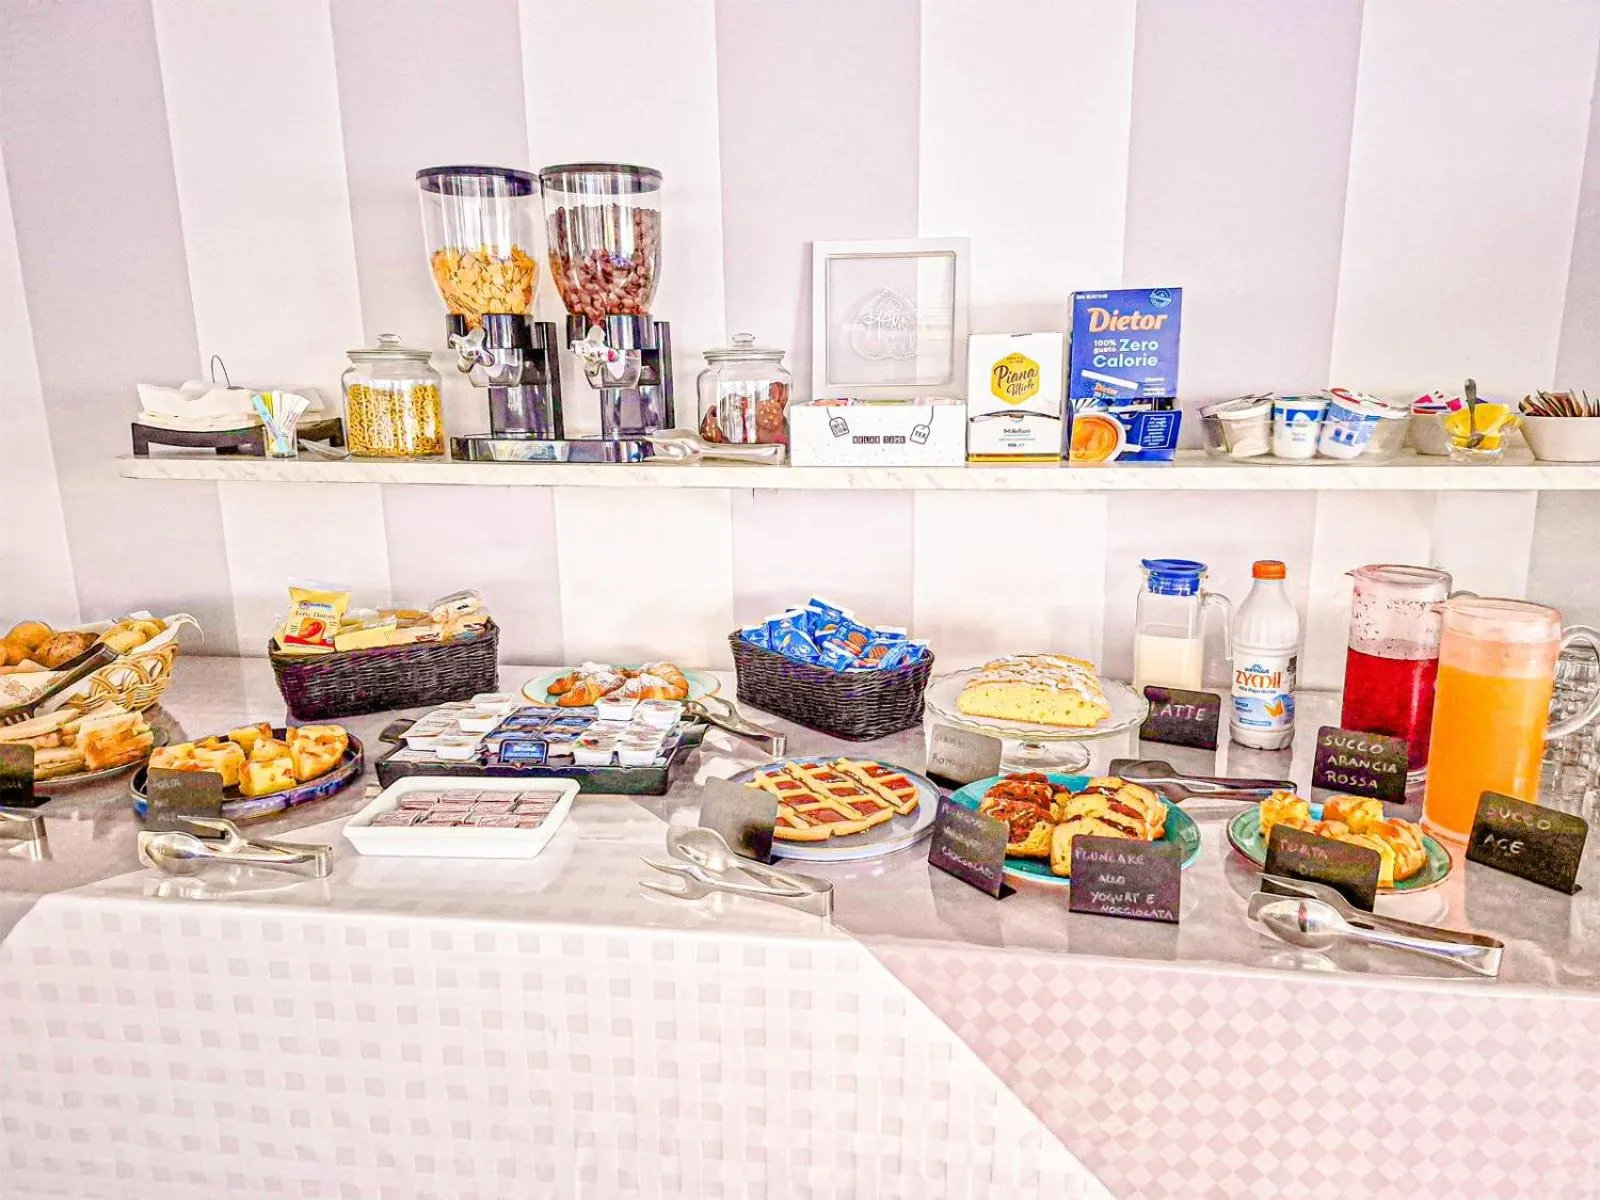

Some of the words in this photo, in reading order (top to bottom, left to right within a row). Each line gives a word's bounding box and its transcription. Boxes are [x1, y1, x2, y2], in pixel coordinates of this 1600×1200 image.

[1087, 307, 1169, 333] Dietor
[1093, 339, 1117, 348] 100%
[1119, 338, 1159, 352] Zero
[1093, 347, 1117, 355] gusto
[1093, 353, 1158, 368] Calorie
[993, 364, 1036, 389] Piana
[1323, 735, 1384, 754] SUCCO
[1327, 755, 1397, 774] ARANCIA
[1324, 770, 1378, 790] ROSSA
[1484, 834, 1525, 854] ACE
[1098, 873, 1126, 885] ALLO
[1147, 894, 1155, 904] E
